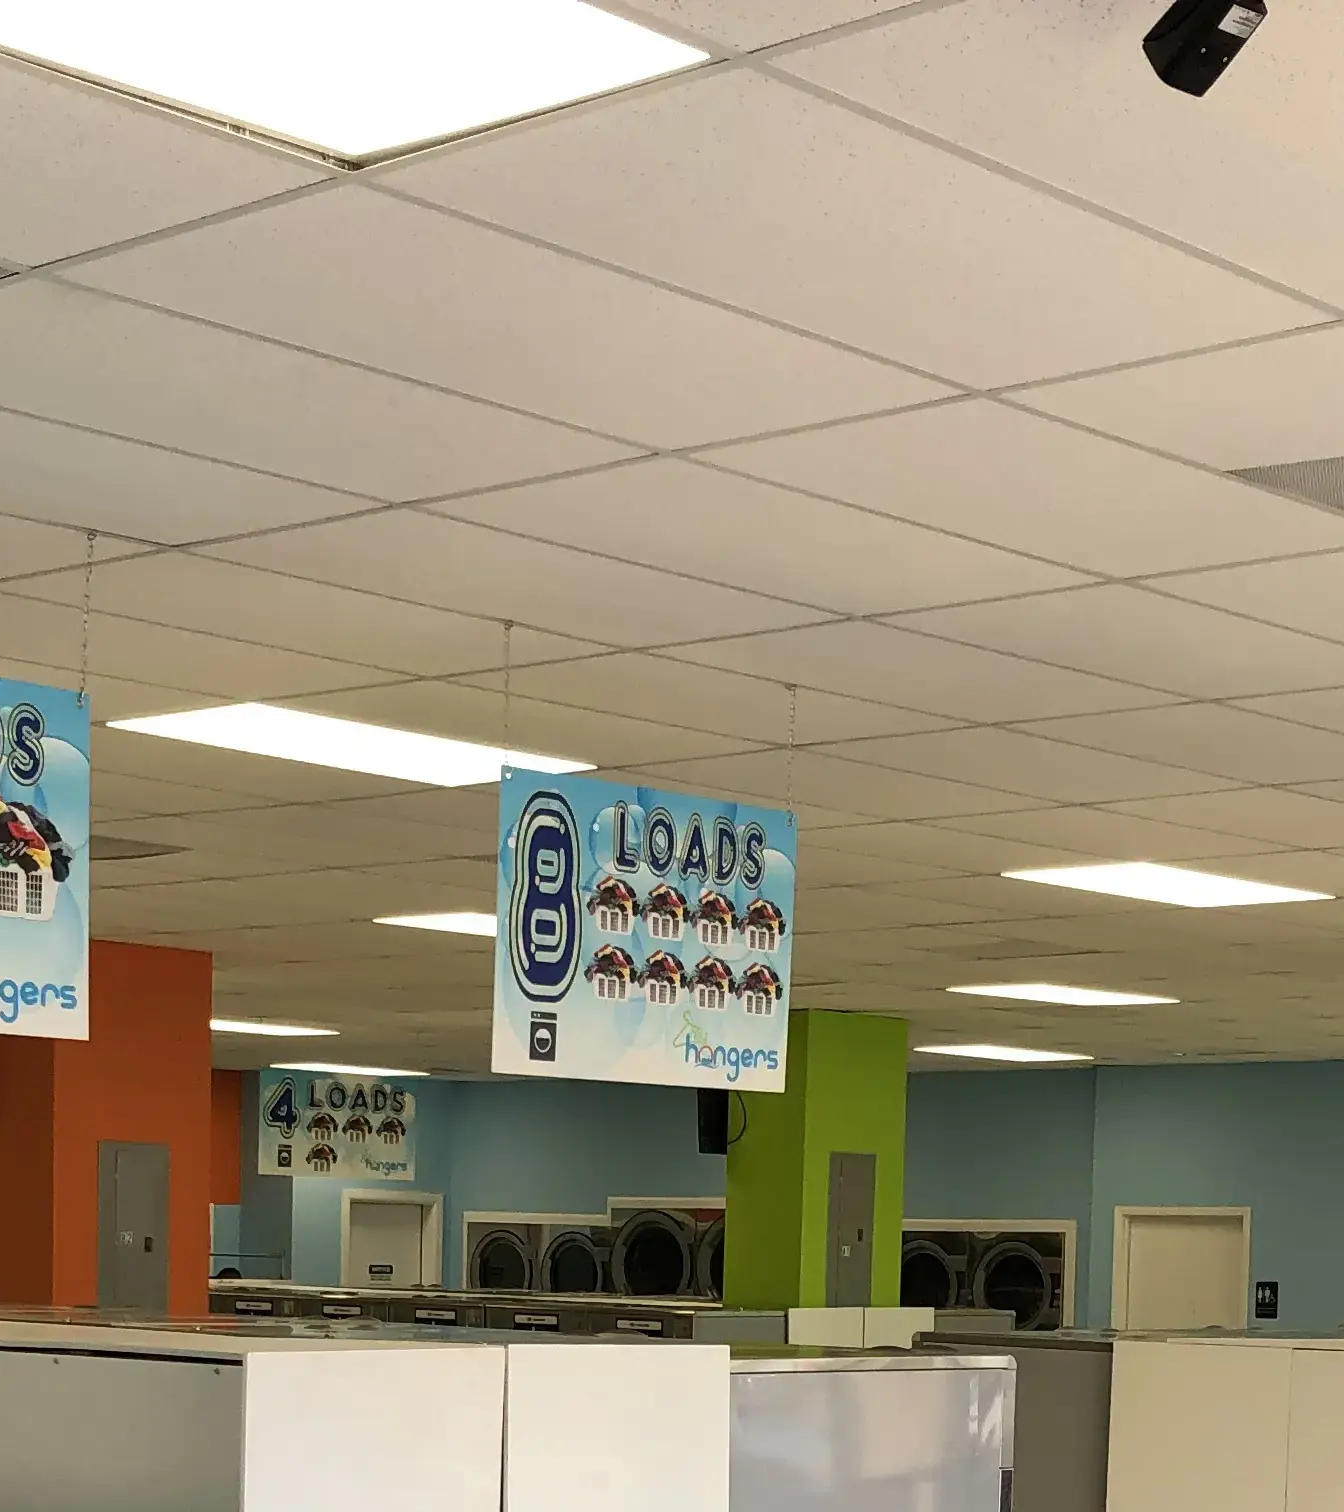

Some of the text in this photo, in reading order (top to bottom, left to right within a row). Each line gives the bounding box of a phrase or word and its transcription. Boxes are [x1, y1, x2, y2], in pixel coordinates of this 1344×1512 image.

[509, 790, 765, 1003] 8 LOADS
[685, 1033, 778, 1082] hangers
[263, 1076, 407, 1139] 4 LOADS
